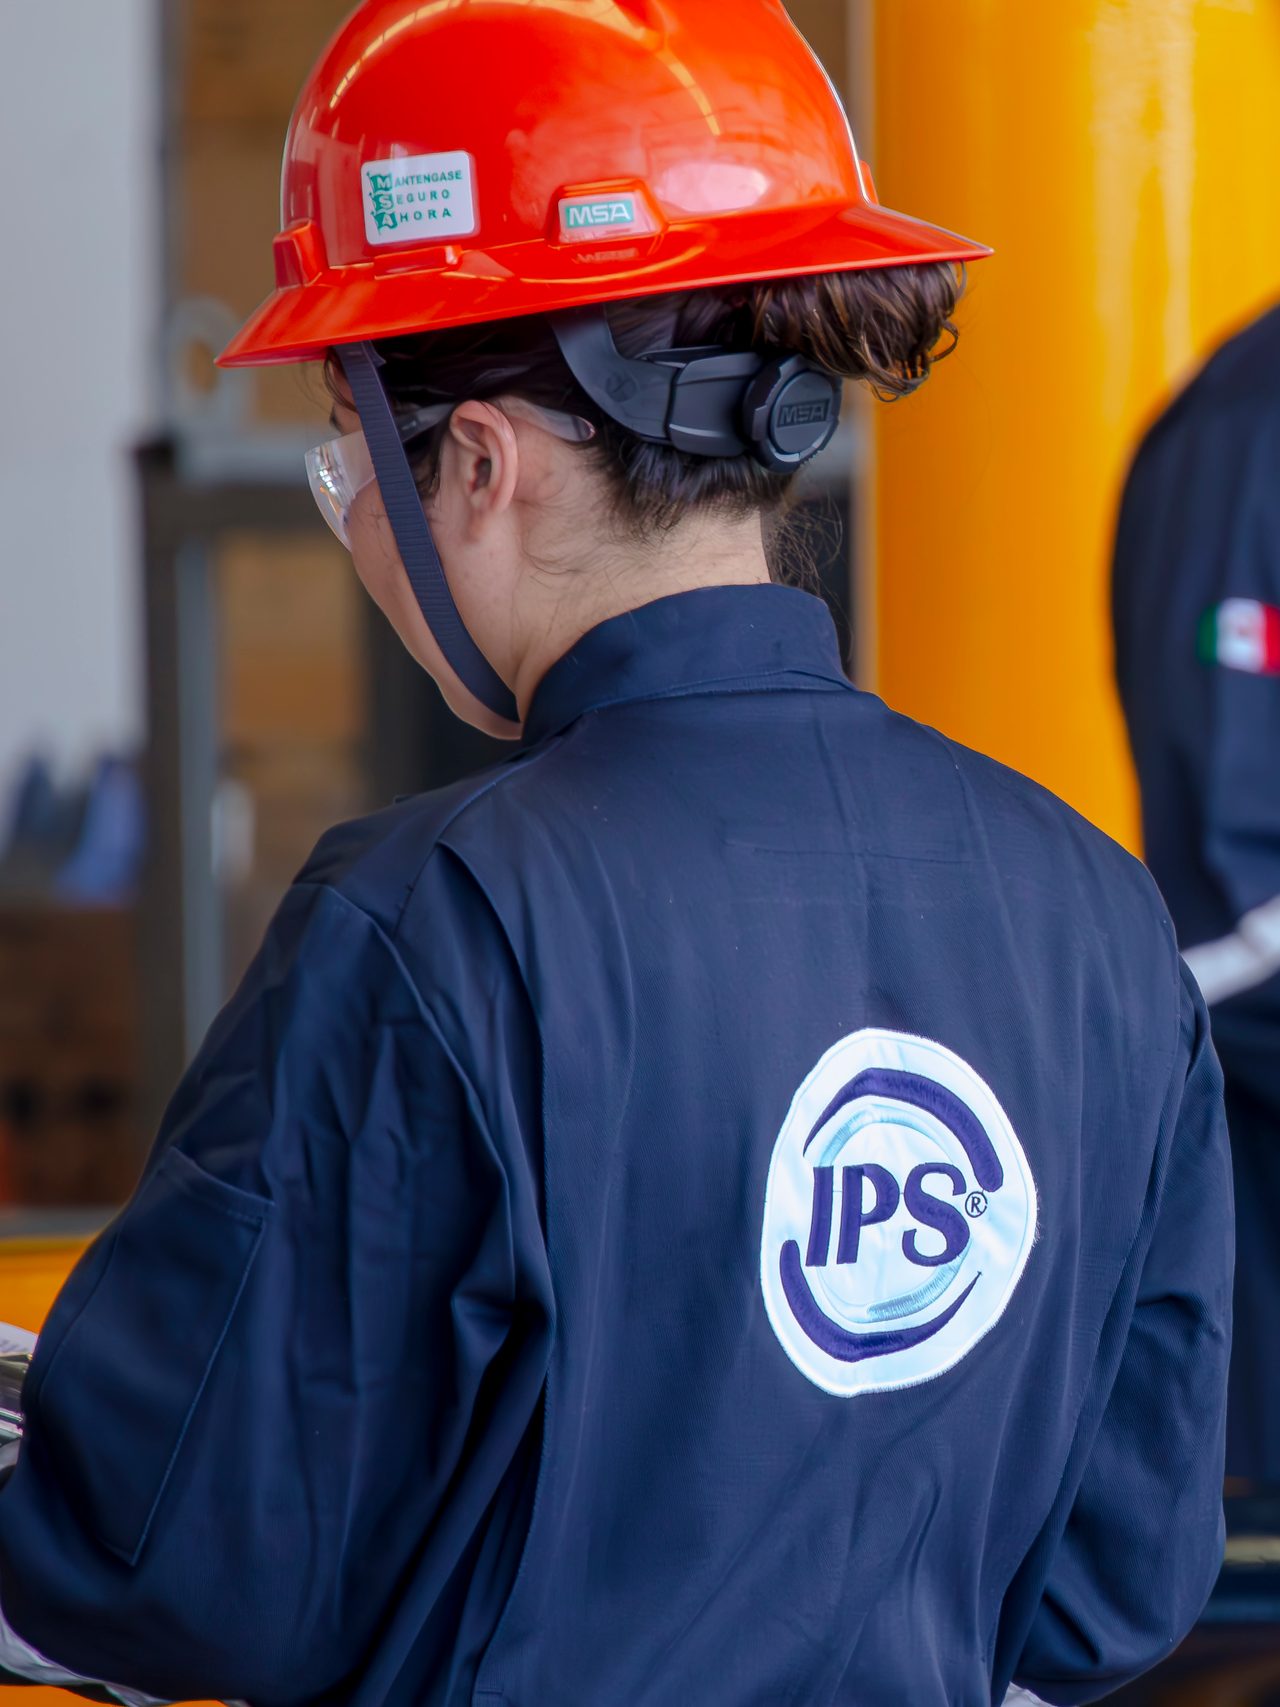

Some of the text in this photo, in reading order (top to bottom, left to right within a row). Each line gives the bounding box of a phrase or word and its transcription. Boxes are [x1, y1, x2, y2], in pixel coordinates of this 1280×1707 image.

[378, 189, 450, 210] SEGURO
[380, 208, 452, 229] AHORA
[569, 203, 631, 226] MSA
[780, 404, 826, 425] MSA
